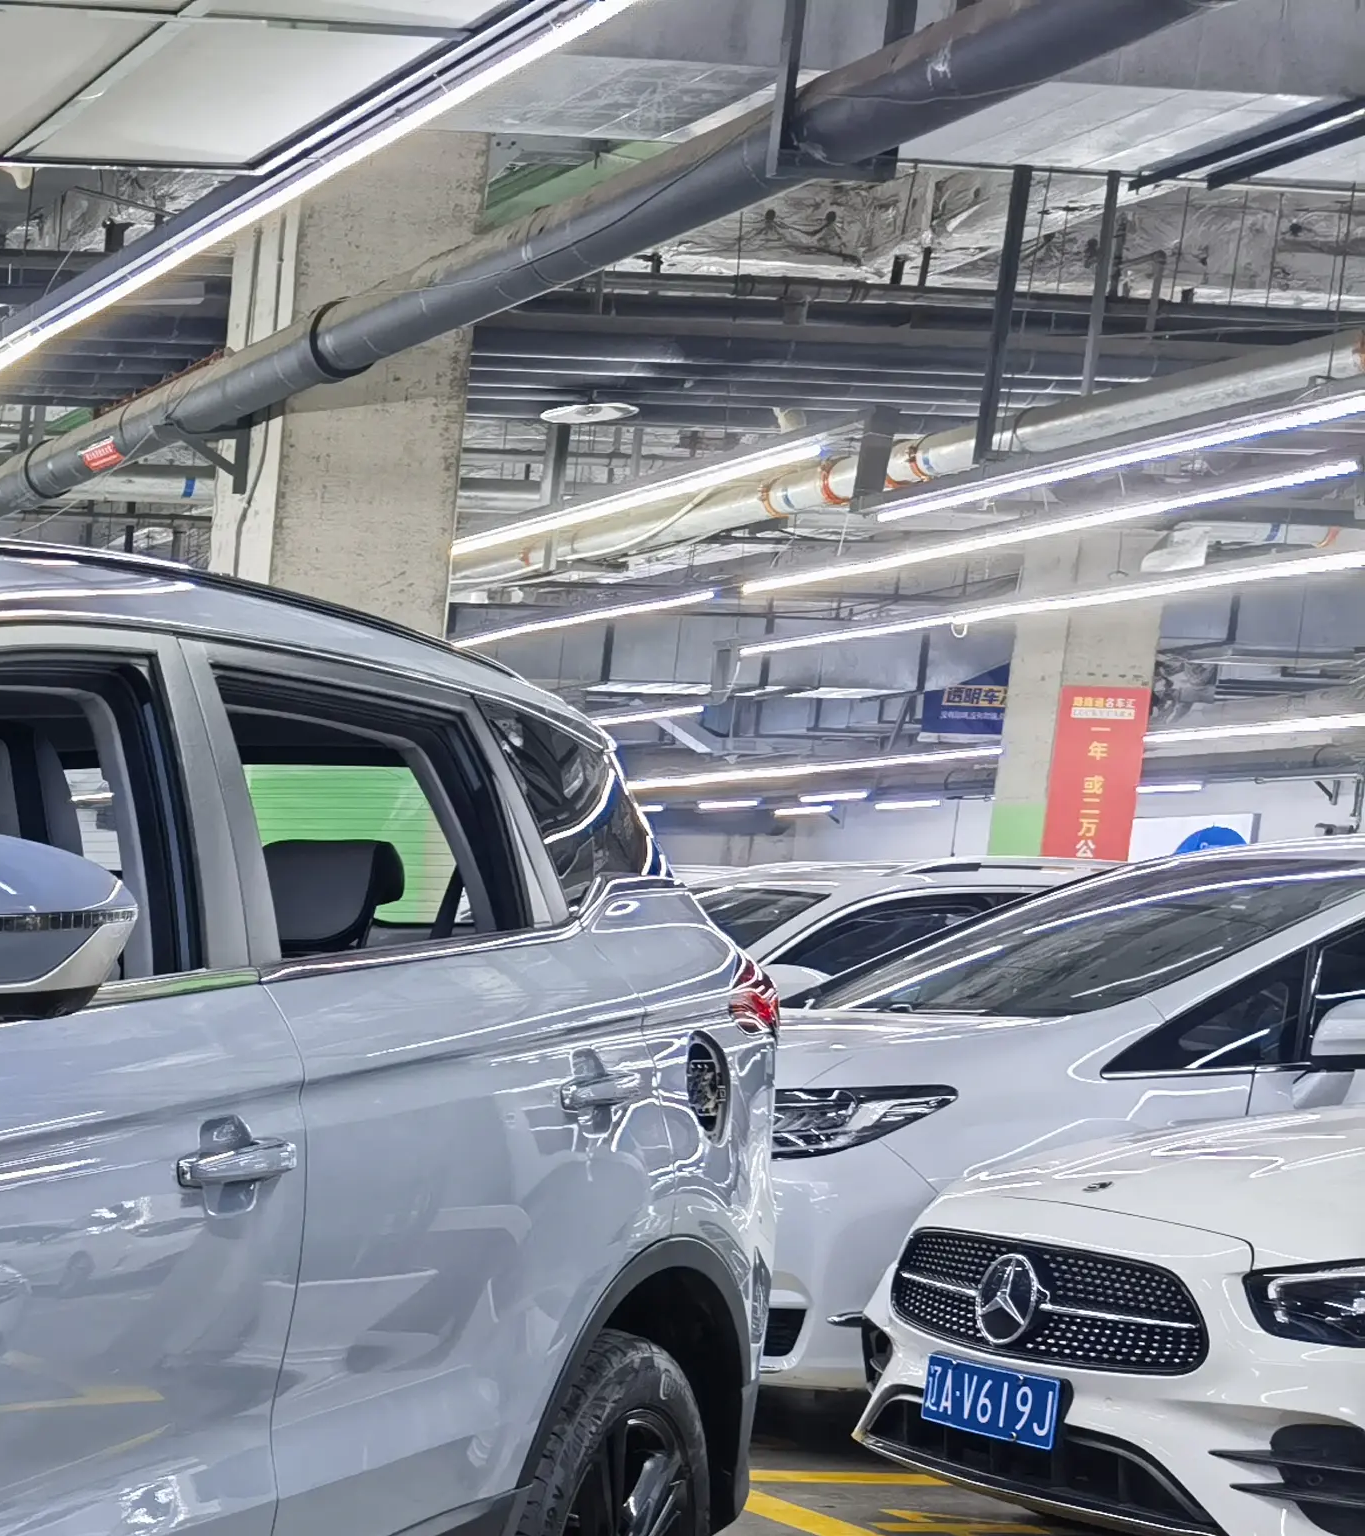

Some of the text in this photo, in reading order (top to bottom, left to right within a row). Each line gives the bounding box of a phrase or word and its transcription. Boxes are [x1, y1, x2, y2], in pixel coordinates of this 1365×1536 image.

[947, 686, 1008, 705] 透明车
[1087, 726, 1111, 760] 一年
